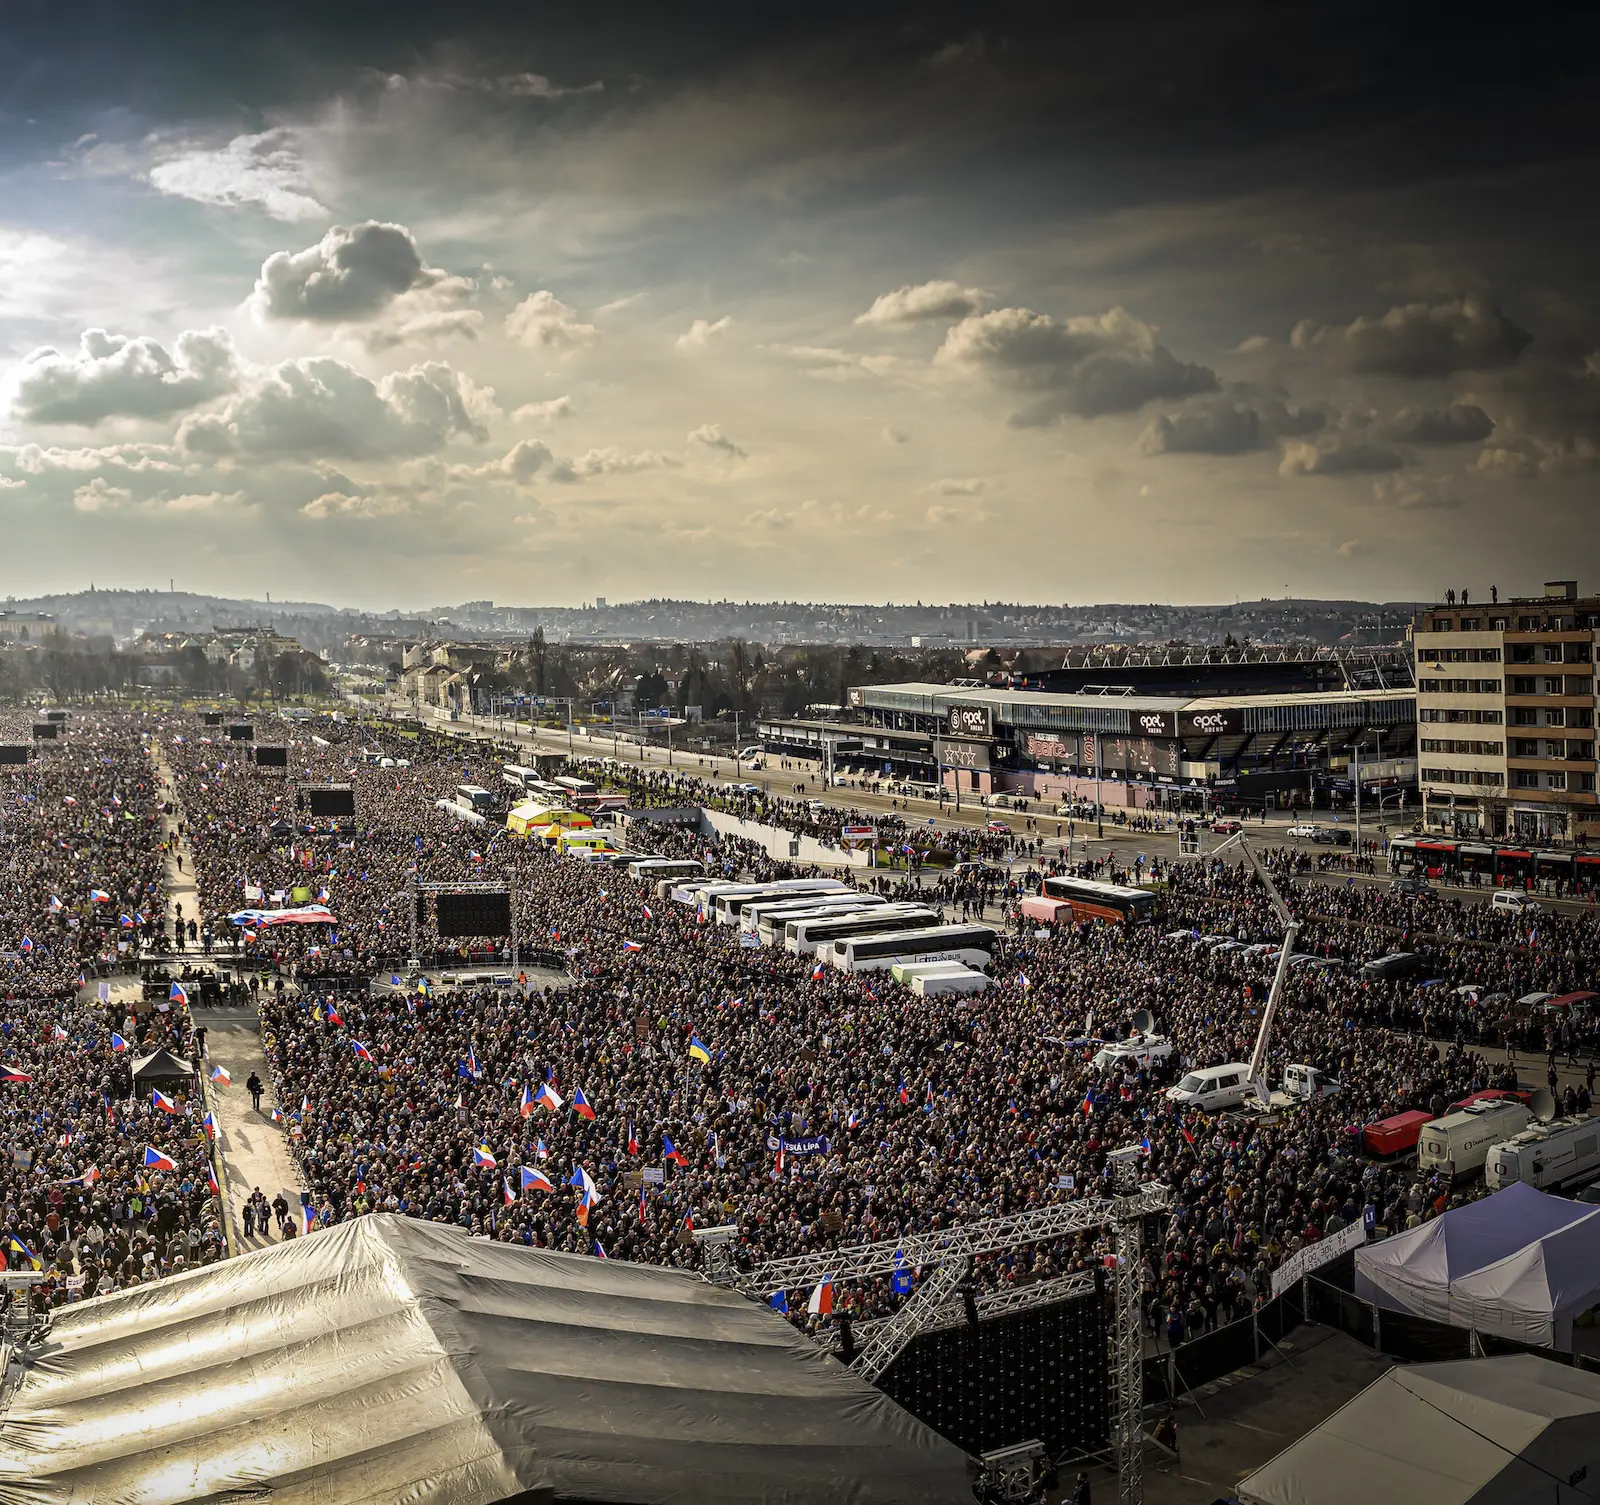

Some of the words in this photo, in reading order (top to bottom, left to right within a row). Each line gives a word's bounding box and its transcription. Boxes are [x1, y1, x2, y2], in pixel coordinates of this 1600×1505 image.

[1027, 735, 1066, 760] Sparta
[803, 1141, 820, 1151] LÍPA
[1365, 1211, 1374, 1223] L1
